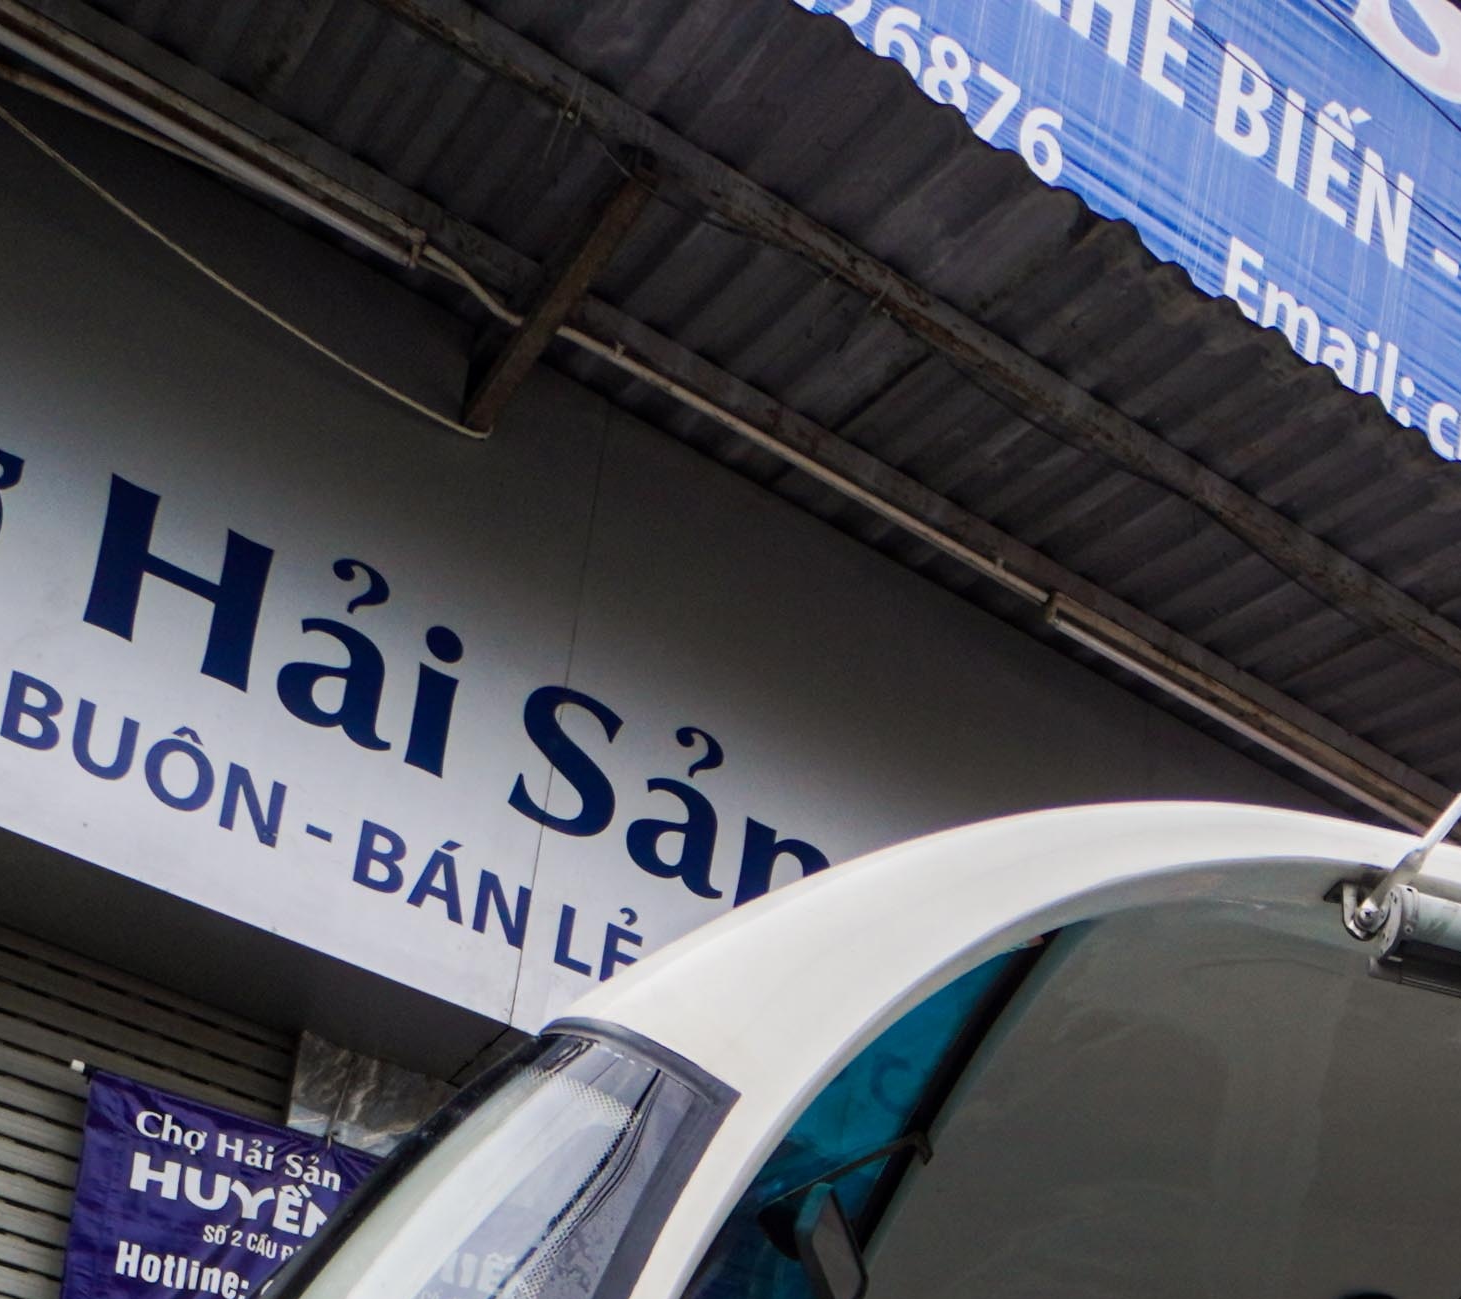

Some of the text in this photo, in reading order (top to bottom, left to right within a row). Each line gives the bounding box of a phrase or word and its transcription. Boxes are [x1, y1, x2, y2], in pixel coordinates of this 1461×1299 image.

[1216, 41, 1415, 269] BIẾN
[1224, 236, 1417, 428] Email:
[82, 472, 465, 779] Hải
[506, 685, 833, 909] Sản
[0, 671, 288, 848] BUÔN
[352, 820, 532, 951] BÁN
[553, 903, 644, 983] LẺ
[136, 1110, 342, 1192] Chợ Hải Sản
[231, 1230, 244, 1248] 2
